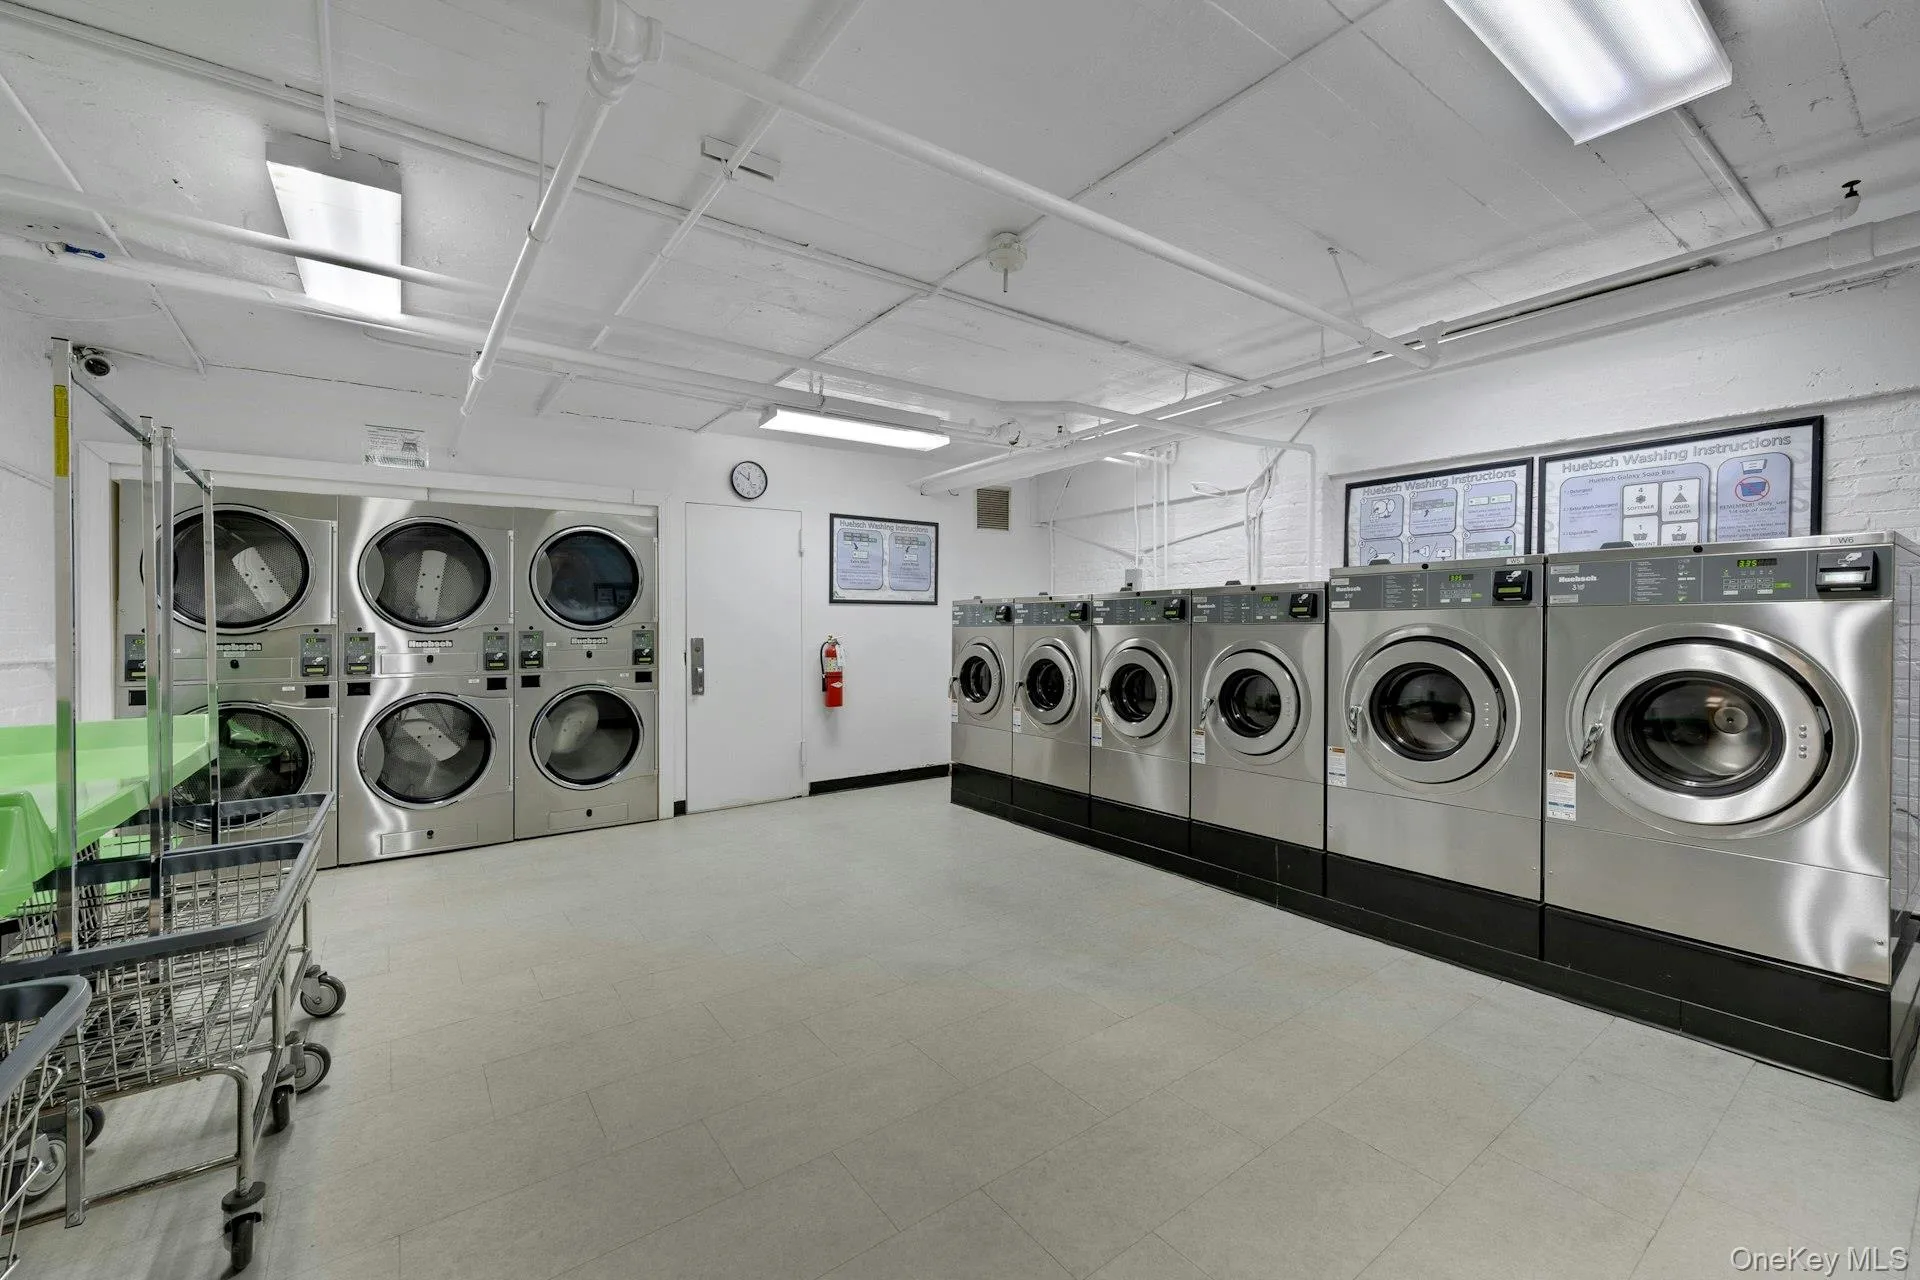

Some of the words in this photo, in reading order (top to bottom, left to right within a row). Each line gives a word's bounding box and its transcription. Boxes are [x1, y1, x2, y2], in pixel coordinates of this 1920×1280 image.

[1562, 456, 1619, 473] Huebsch
[1622, 447, 1689, 465] Washing
[1693, 435, 1792, 457] Instructions
[1618, 472, 1641, 481] Galaxy
[1642, 469, 1660, 478] Soap
[1662, 468, 1676, 476] Box
[1362, 483, 1402, 496] Huebsch
[1405, 476, 1449, 491] Washing
[1451, 468, 1517, 485] Instructions
[1626, 504, 1655, 512] SOFTENER
[1669, 503, 1690, 511] LIQUID
[840, 520, 867, 529] Huebsch
[868, 522, 894, 532] Washing
[896, 524, 929, 533] Instructions
[1558, 575, 1598, 583] Huebsch
[216, 643, 262, 651] uebsch
[408, 640, 453, 648] Huebsch
